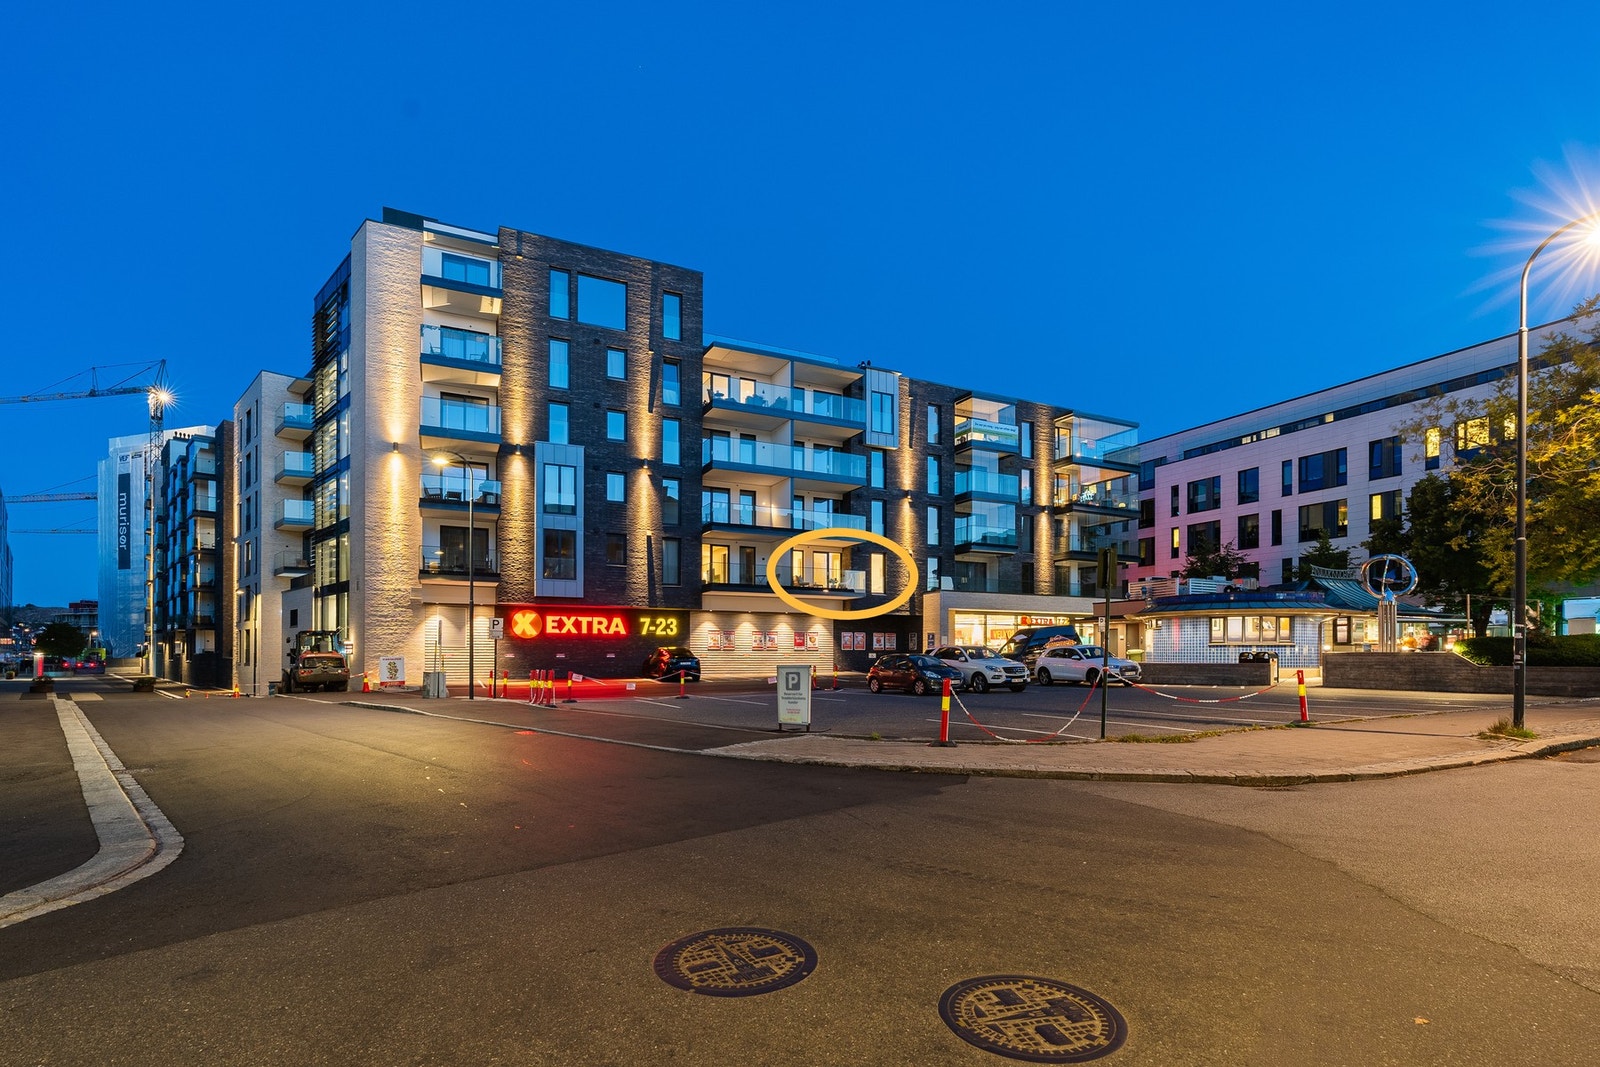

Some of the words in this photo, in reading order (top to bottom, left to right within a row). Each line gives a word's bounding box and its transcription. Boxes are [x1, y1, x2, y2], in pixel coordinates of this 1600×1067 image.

[119, 492, 129, 550] murisør
[492, 619, 500, 630] P
[545, 615, 627, 635] EXTRA
[639, 617, 678, 636] 7-23
[788, 674, 798, 688] P
